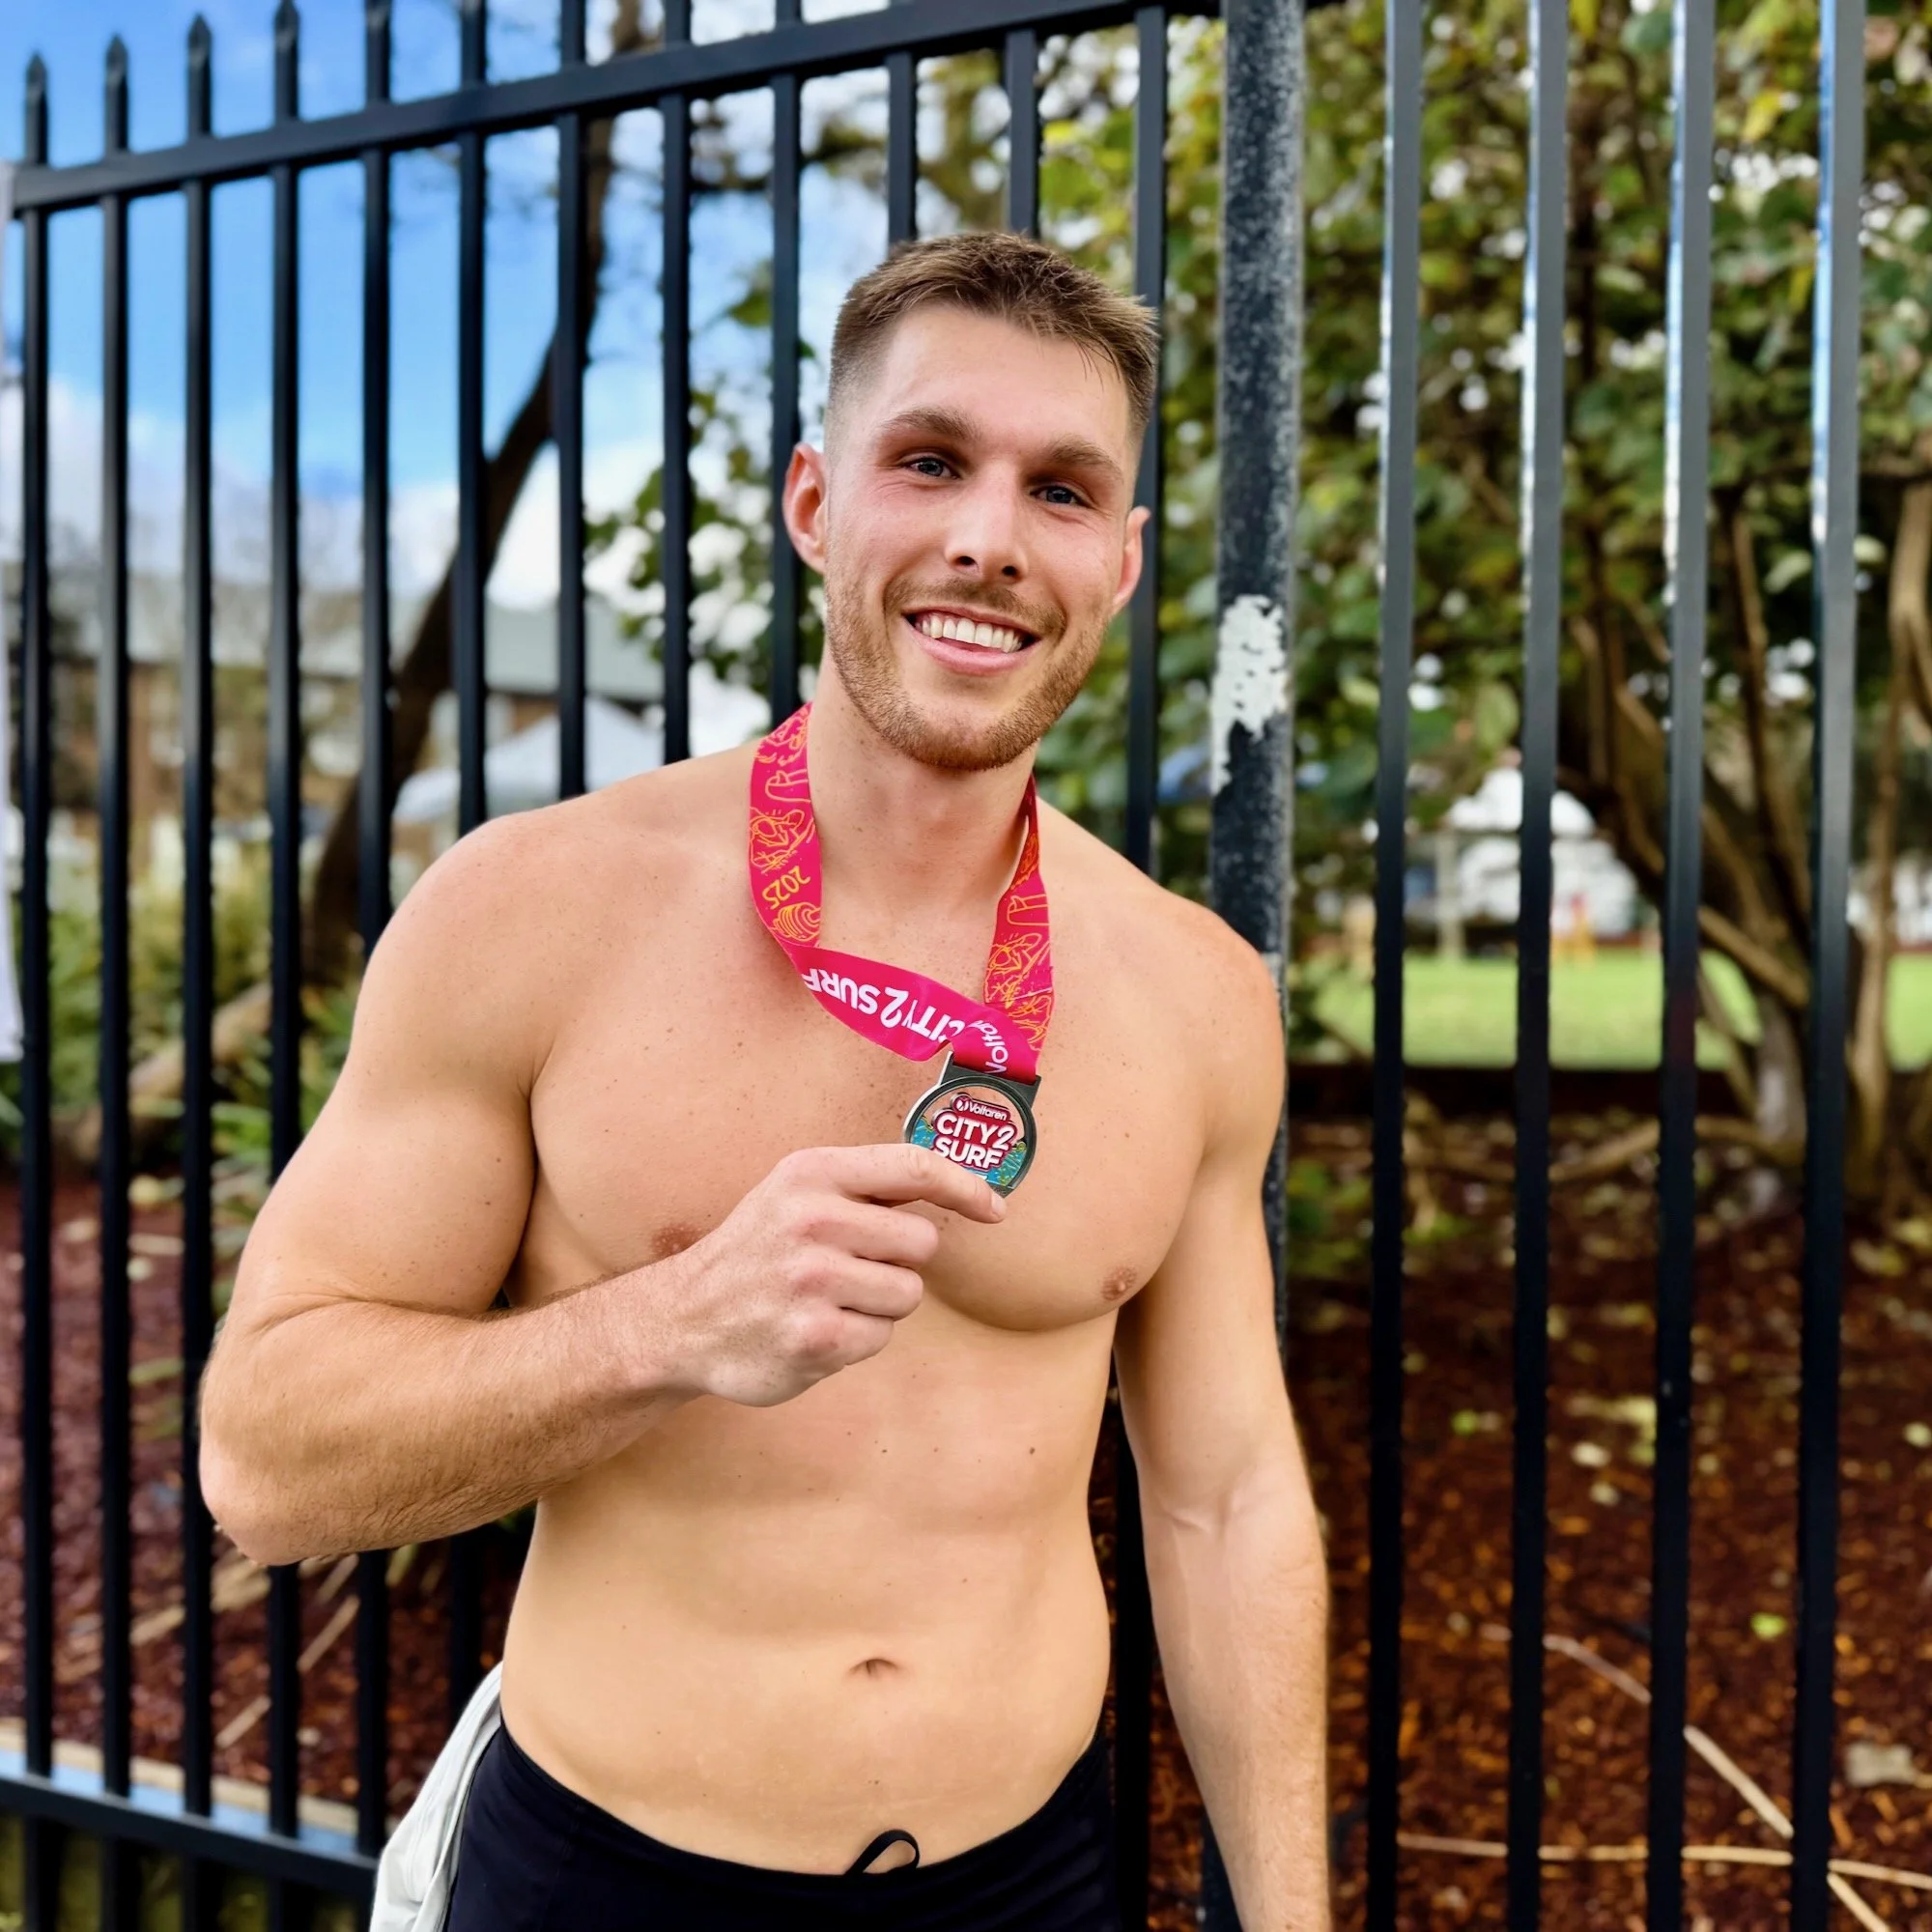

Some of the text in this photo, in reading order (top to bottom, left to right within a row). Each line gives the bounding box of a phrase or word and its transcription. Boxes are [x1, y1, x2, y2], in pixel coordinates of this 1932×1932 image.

[762, 866, 810, 909] 2025
[969, 1101, 1007, 1121] Voltaren
[936, 1114, 1015, 1151] CITY2
[934, 1137, 1004, 1169] SURF
